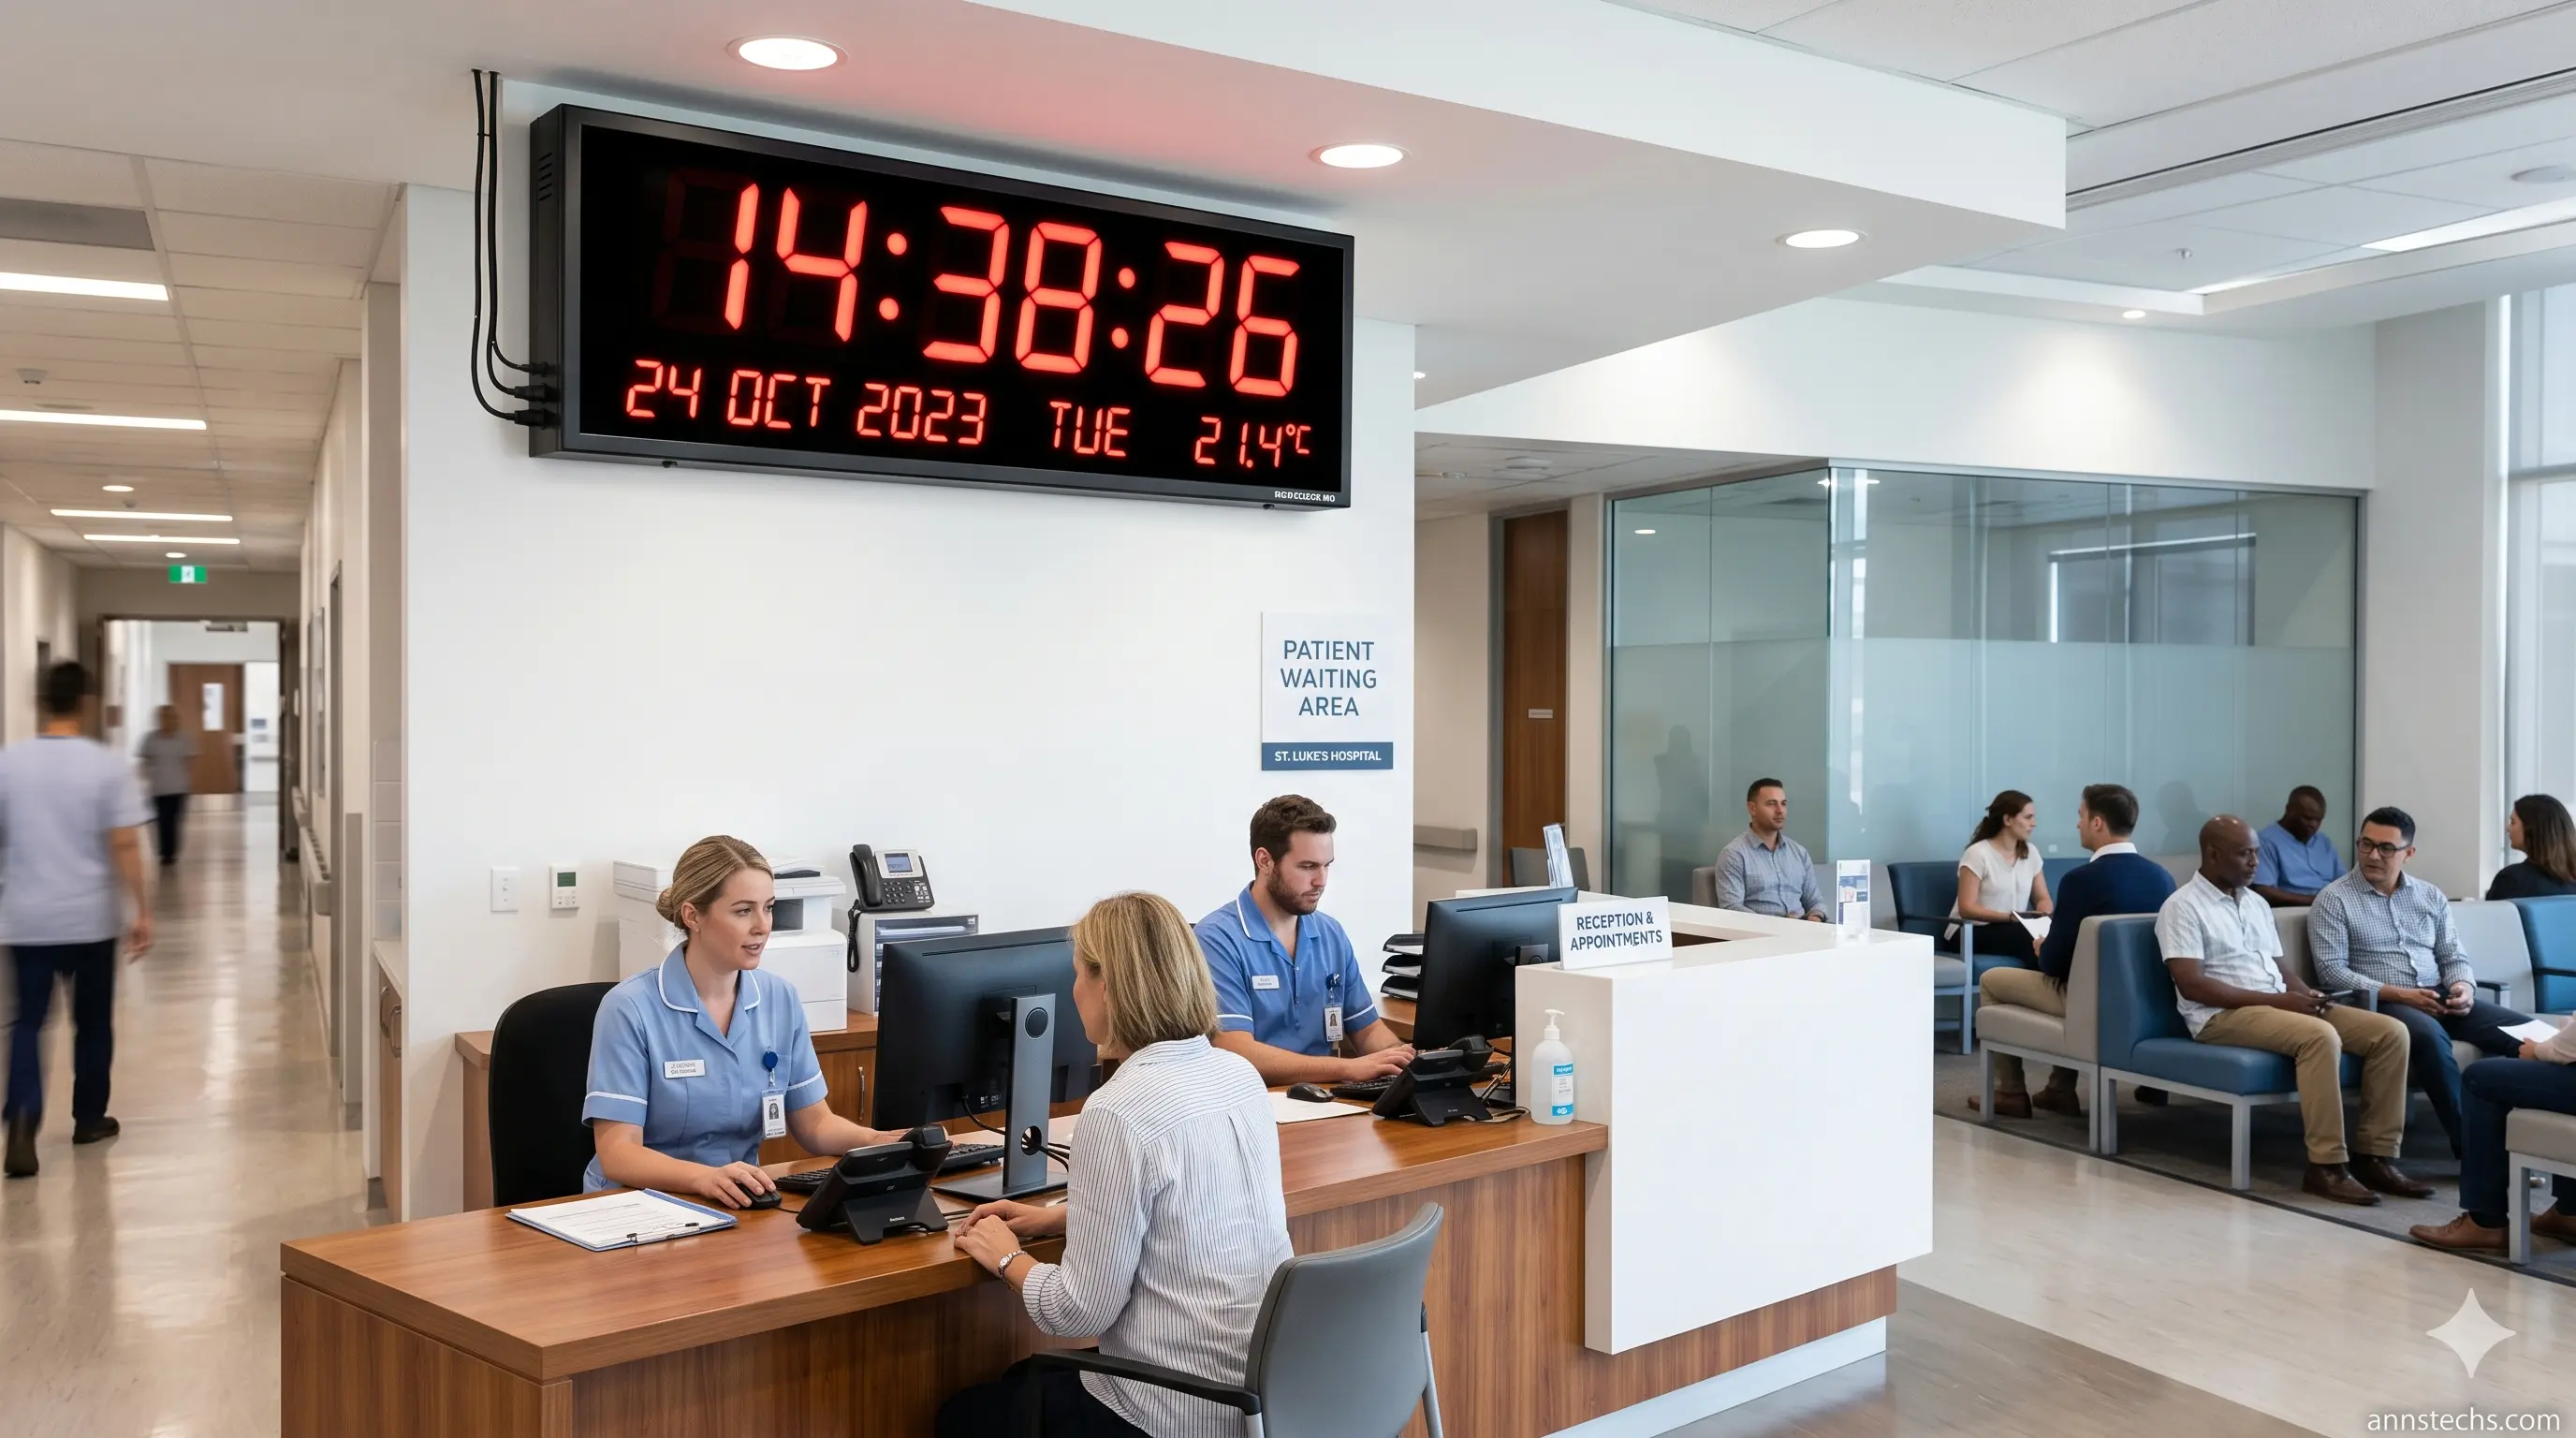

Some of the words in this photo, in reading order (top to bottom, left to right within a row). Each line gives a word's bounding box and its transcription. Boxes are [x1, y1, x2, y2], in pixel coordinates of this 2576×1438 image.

[724, 183, 1300, 398] 14:38:26
[625, 360, 702, 418] 24
[726, 370, 831, 430] OCT
[856, 383, 987, 446] 2023
[1049, 402, 1131, 458] TUE
[1283, 639, 1375, 661] PATIENT
[1280, 668, 1377, 689] WAITING
[1298, 696, 1359, 716] AREA
[1274, 751, 1291, 762] ST.
[1330, 751, 1382, 761] HOSPITAL
[1576, 911, 1644, 931] RECEPTION
[1646, 911, 1654, 925] &
[1570, 930, 1663, 951] APPOINTMENTS
